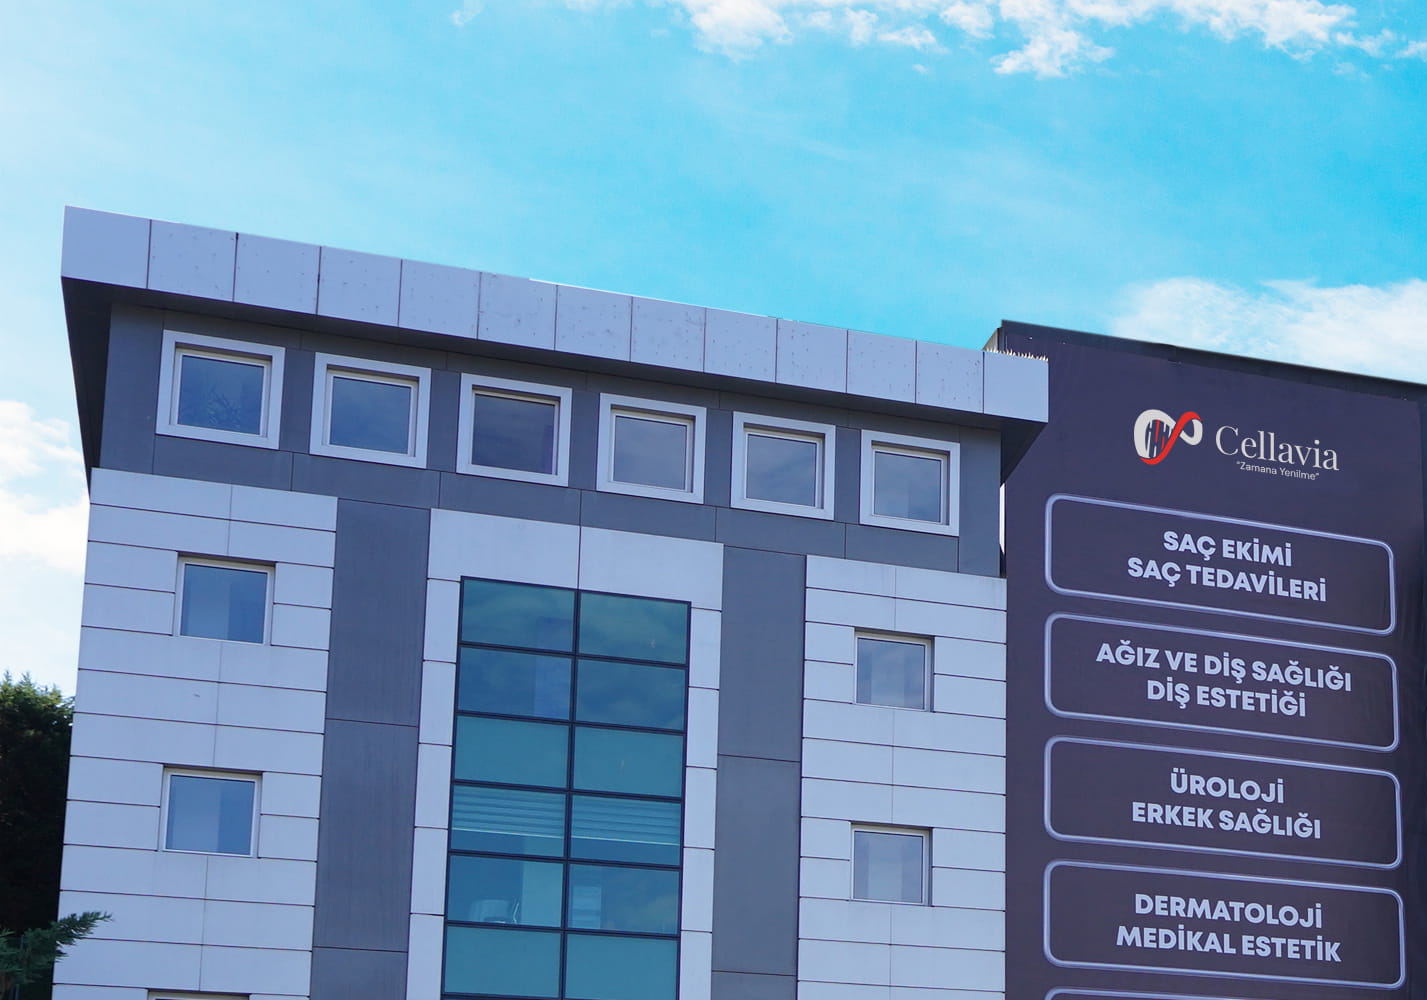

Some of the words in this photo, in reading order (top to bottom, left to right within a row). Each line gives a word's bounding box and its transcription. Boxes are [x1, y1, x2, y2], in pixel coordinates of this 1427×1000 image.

[1215, 425, 1340, 471] Cellavia
[1163, 530, 1217, 562] SAÇ
[1222, 537, 1293, 567] EKİMİ
[1127, 557, 1181, 588] SAÇ
[1185, 564, 1327, 602] TEDAVİLERİ
[1096, 639, 1160, 669] AĞIZ
[1165, 651, 1197, 673] VE
[1204, 651, 1246, 682] DİŞ
[1252, 660, 1352, 692] SAĞLIĞI
[1147, 676, 1190, 709] DİŞ
[1196, 686, 1306, 717] ESTETİĞİ
[1170, 767, 1284, 803] ÜROLOJİ
[1132, 801, 1214, 829] ERKEK
[1219, 808, 1321, 839] SAĞLIĞI
[1135, 893, 1322, 929] DERMATOLOJİ
[1116, 924, 1237, 954] MEDİKAL
[1241, 934, 1342, 963] ESTETİK
